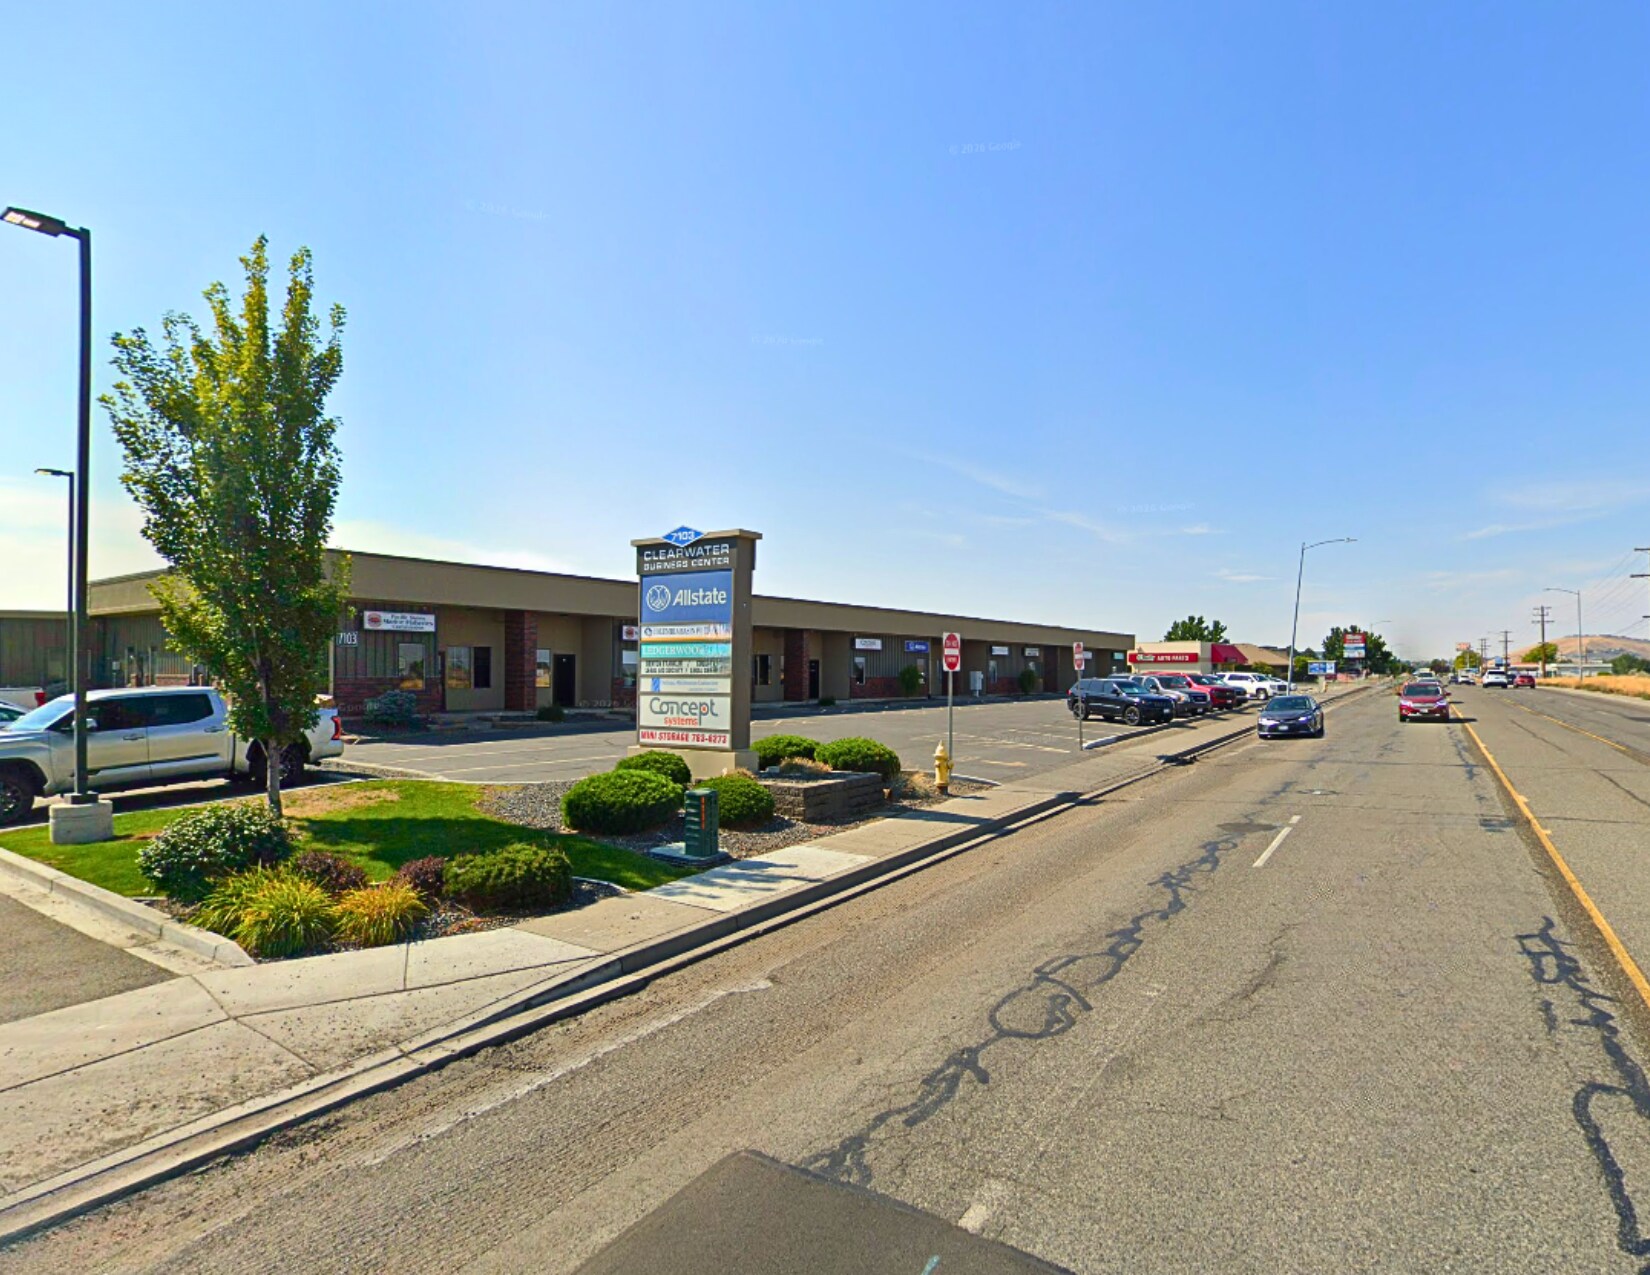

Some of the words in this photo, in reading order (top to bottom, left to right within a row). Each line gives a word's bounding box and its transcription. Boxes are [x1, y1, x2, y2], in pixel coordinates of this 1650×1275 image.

[670, 531, 696, 542] 7103
[643, 543, 730, 561] CLEARWATER
[643, 560, 688, 571] BUSINESS
[691, 557, 730, 567] CENTER
[672, 587, 727, 606] Allstate
[338, 632, 357, 645] 7103
[649, 697, 719, 726] Concept
[663, 716, 699, 728] systems
[641, 730, 657, 740] MINI
[659, 731, 690, 742] STORAGE
